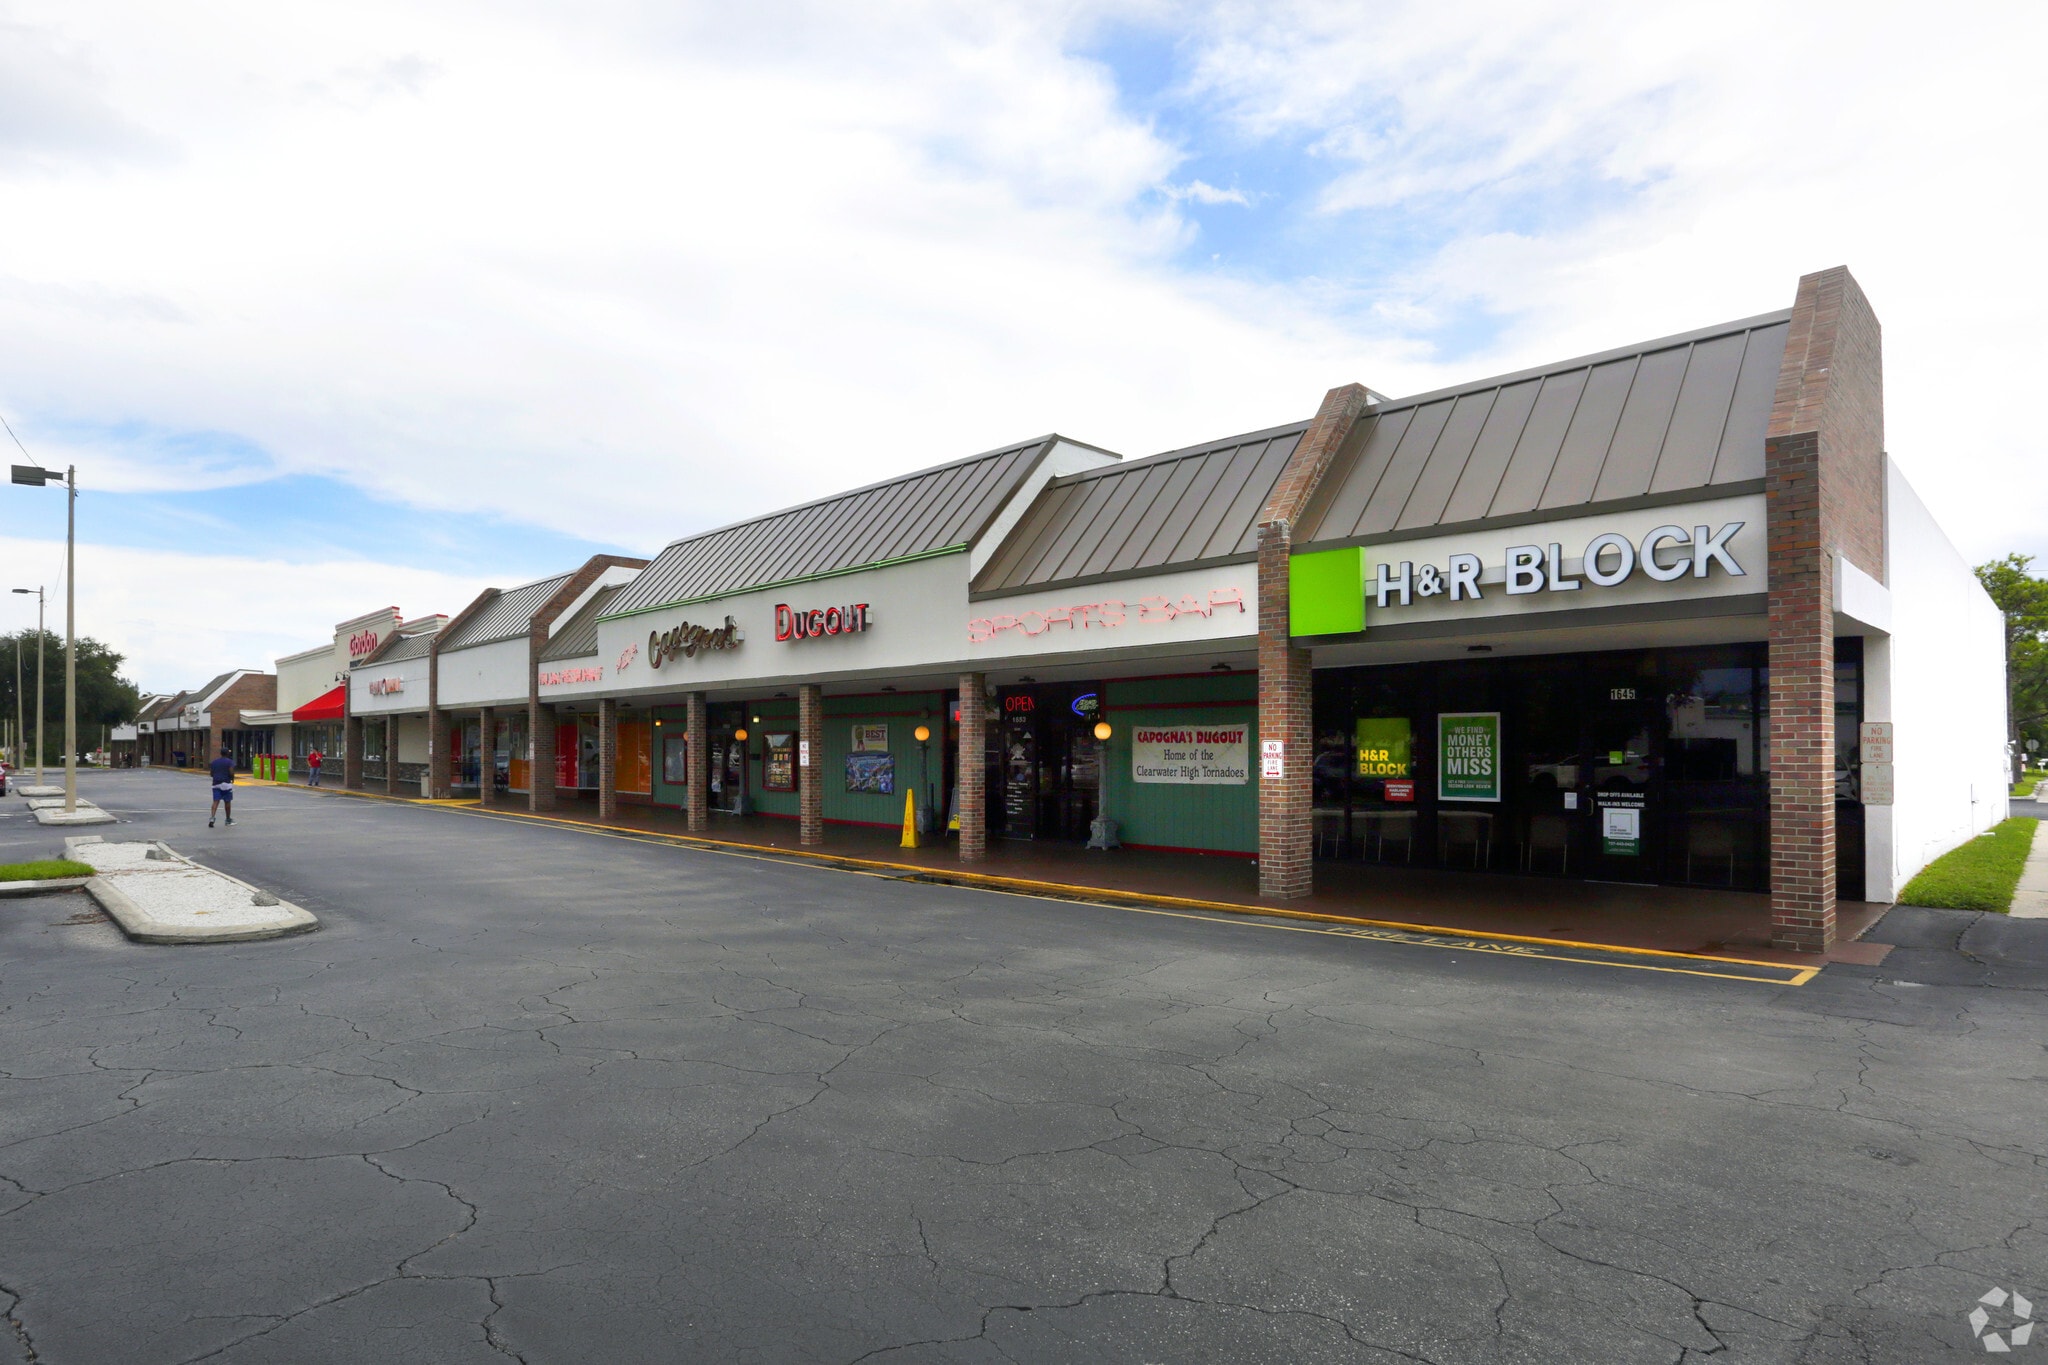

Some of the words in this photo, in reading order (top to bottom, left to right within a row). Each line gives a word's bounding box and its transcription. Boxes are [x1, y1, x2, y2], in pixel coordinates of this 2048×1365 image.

[1377, 552, 1484, 608] H&R
[1504, 521, 1747, 595] BLOCK
[968, 599, 1126, 643] SPORTS
[1139, 588, 1245, 622] BAR
[350, 630, 378, 656] Gordon
[1611, 688, 1635, 700] 1645
[1006, 696, 1034, 711] OPEN
[866, 730, 886, 738] BEST
[1138, 731, 1193, 744] CAPOGNA'S
[1196, 731, 1244, 744] DUGOUT
[1448, 735, 1491, 746] MONEY
[1164, 749, 1186, 760] Home
[1189, 749, 1198, 760] of
[1201, 749, 1214, 760] the
[1360, 750, 1389, 761] H&R
[1448, 747, 1491, 757] OTHERS
[1136, 765, 1178, 777] Clearwater
[1180, 766, 1199, 780] High
[1202, 766, 1245, 778] Tornadoes
[1360, 763, 1406, 775] BLOCK
[1448, 758, 1491, 775] MISS
[1422, 937, 1544, 954] LANE
